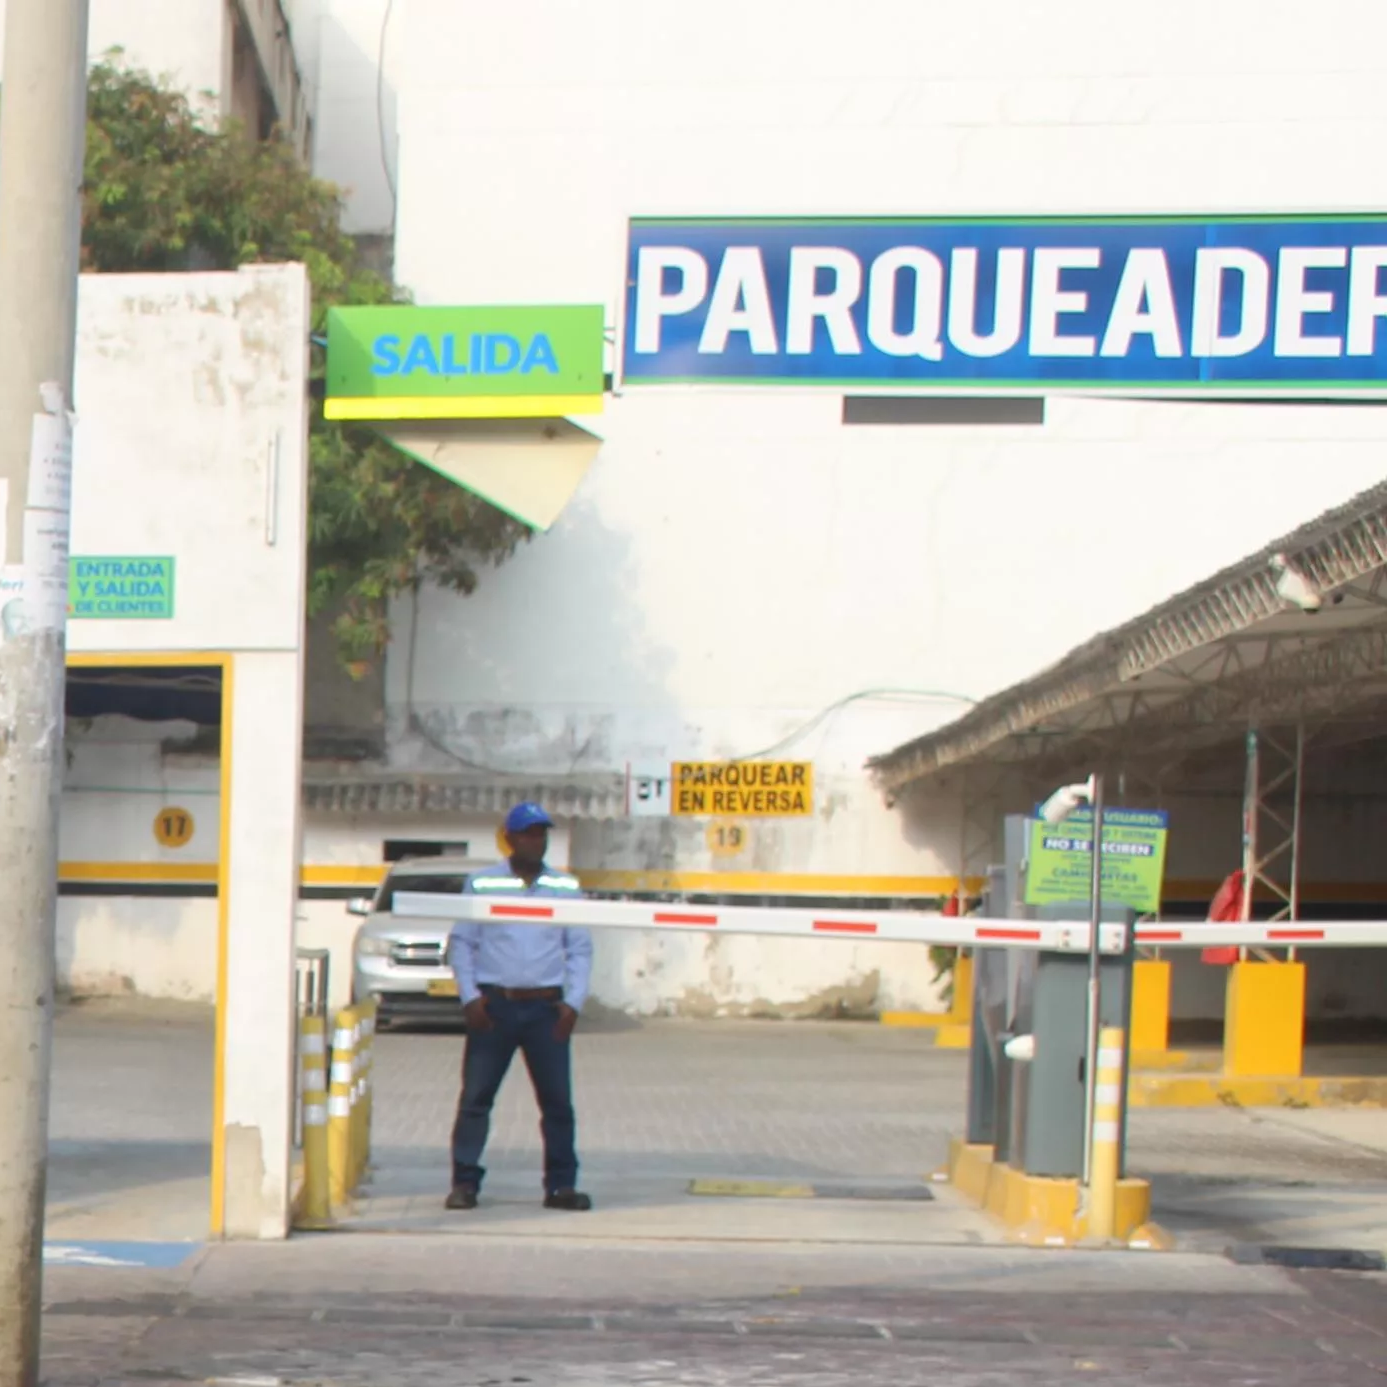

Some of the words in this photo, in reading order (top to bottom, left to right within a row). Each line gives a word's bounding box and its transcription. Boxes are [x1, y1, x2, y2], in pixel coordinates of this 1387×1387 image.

[369, 333, 559, 376] SALIDA
[75, 562, 165, 577] ENTRADA
[77, 580, 90, 597] Y
[94, 580, 165, 597] SALIDA
[75, 600, 93, 613] DE
[96, 600, 165, 613] CLIENTES
[680, 764, 805, 786] PARQUEAR
[679, 790, 705, 812] EN
[712, 790, 805, 812] REVERSA
[162, 815, 186, 837] 17
[717, 827, 742, 847] 19
[1045, 838, 1068, 850] NO
[1073, 840, 1090, 851] SE
